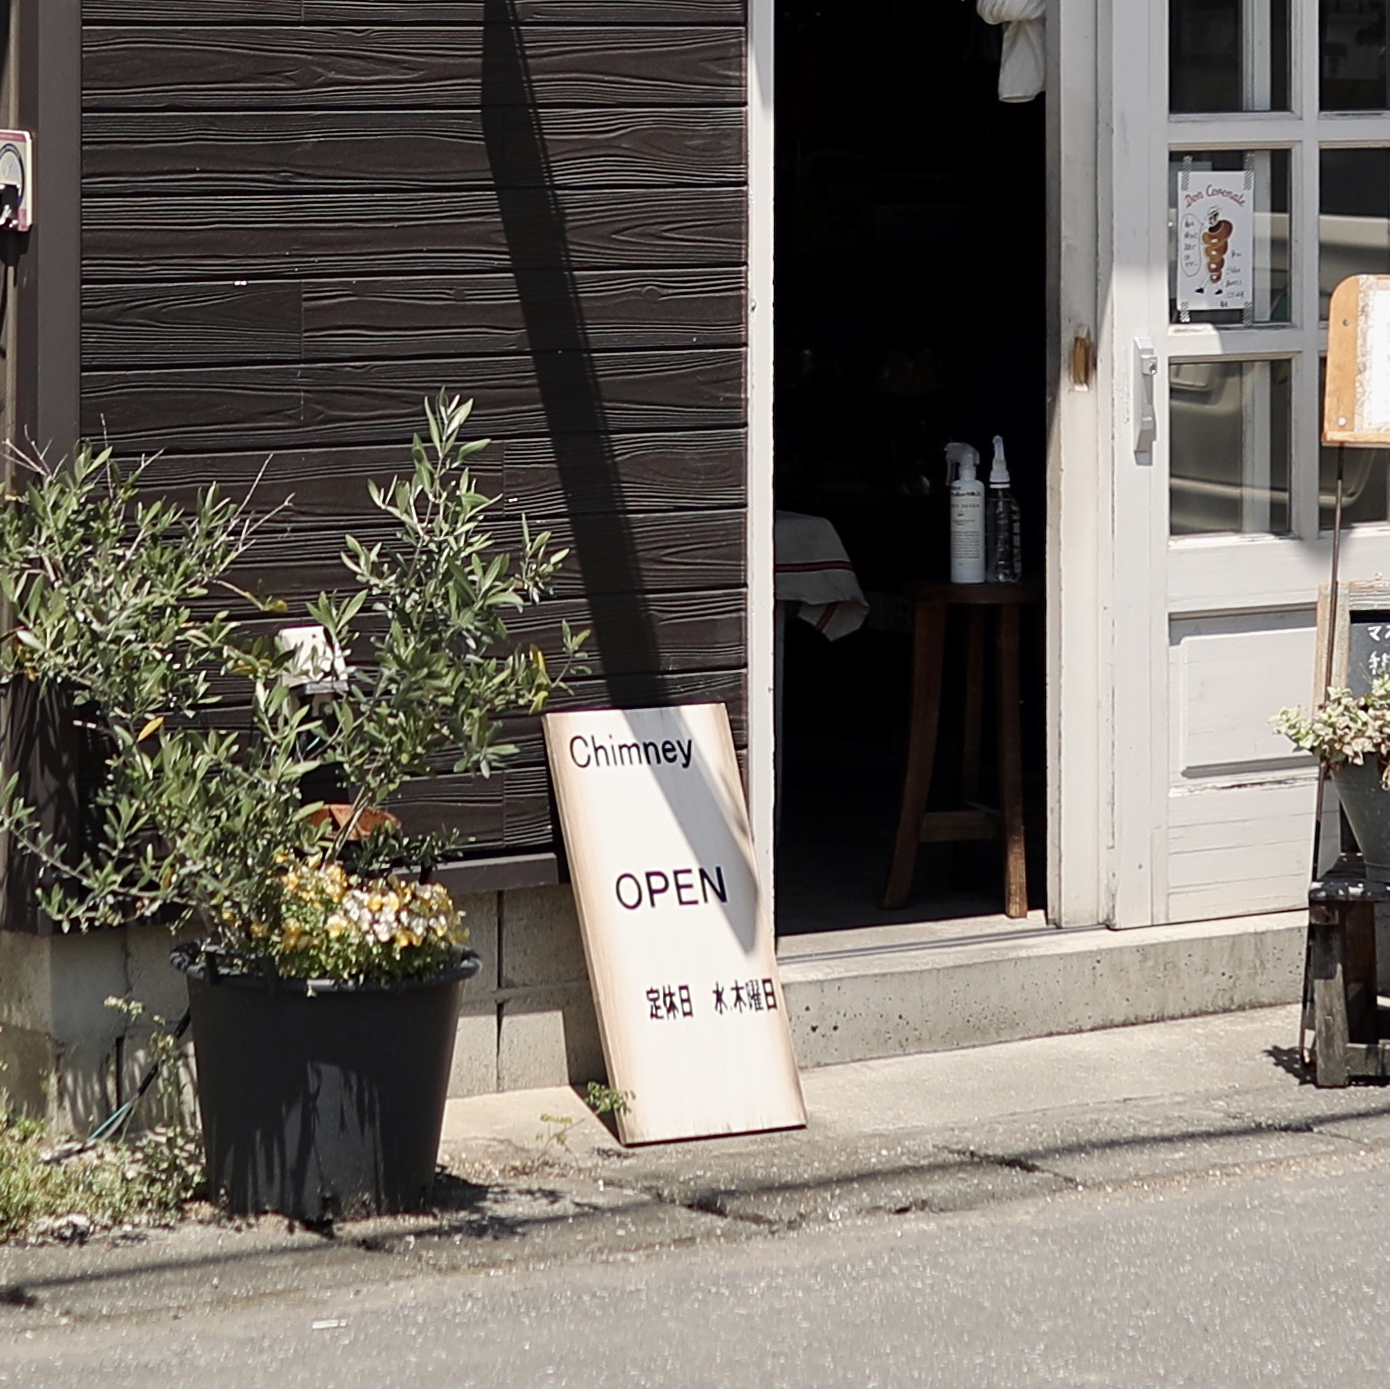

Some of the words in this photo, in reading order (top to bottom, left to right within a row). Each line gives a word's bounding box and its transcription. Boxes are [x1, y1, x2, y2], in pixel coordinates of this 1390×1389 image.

[569, 736, 692, 769] Chimney
[616, 866, 728, 909] OPEN
[645, 983, 694, 1020] 定休日
